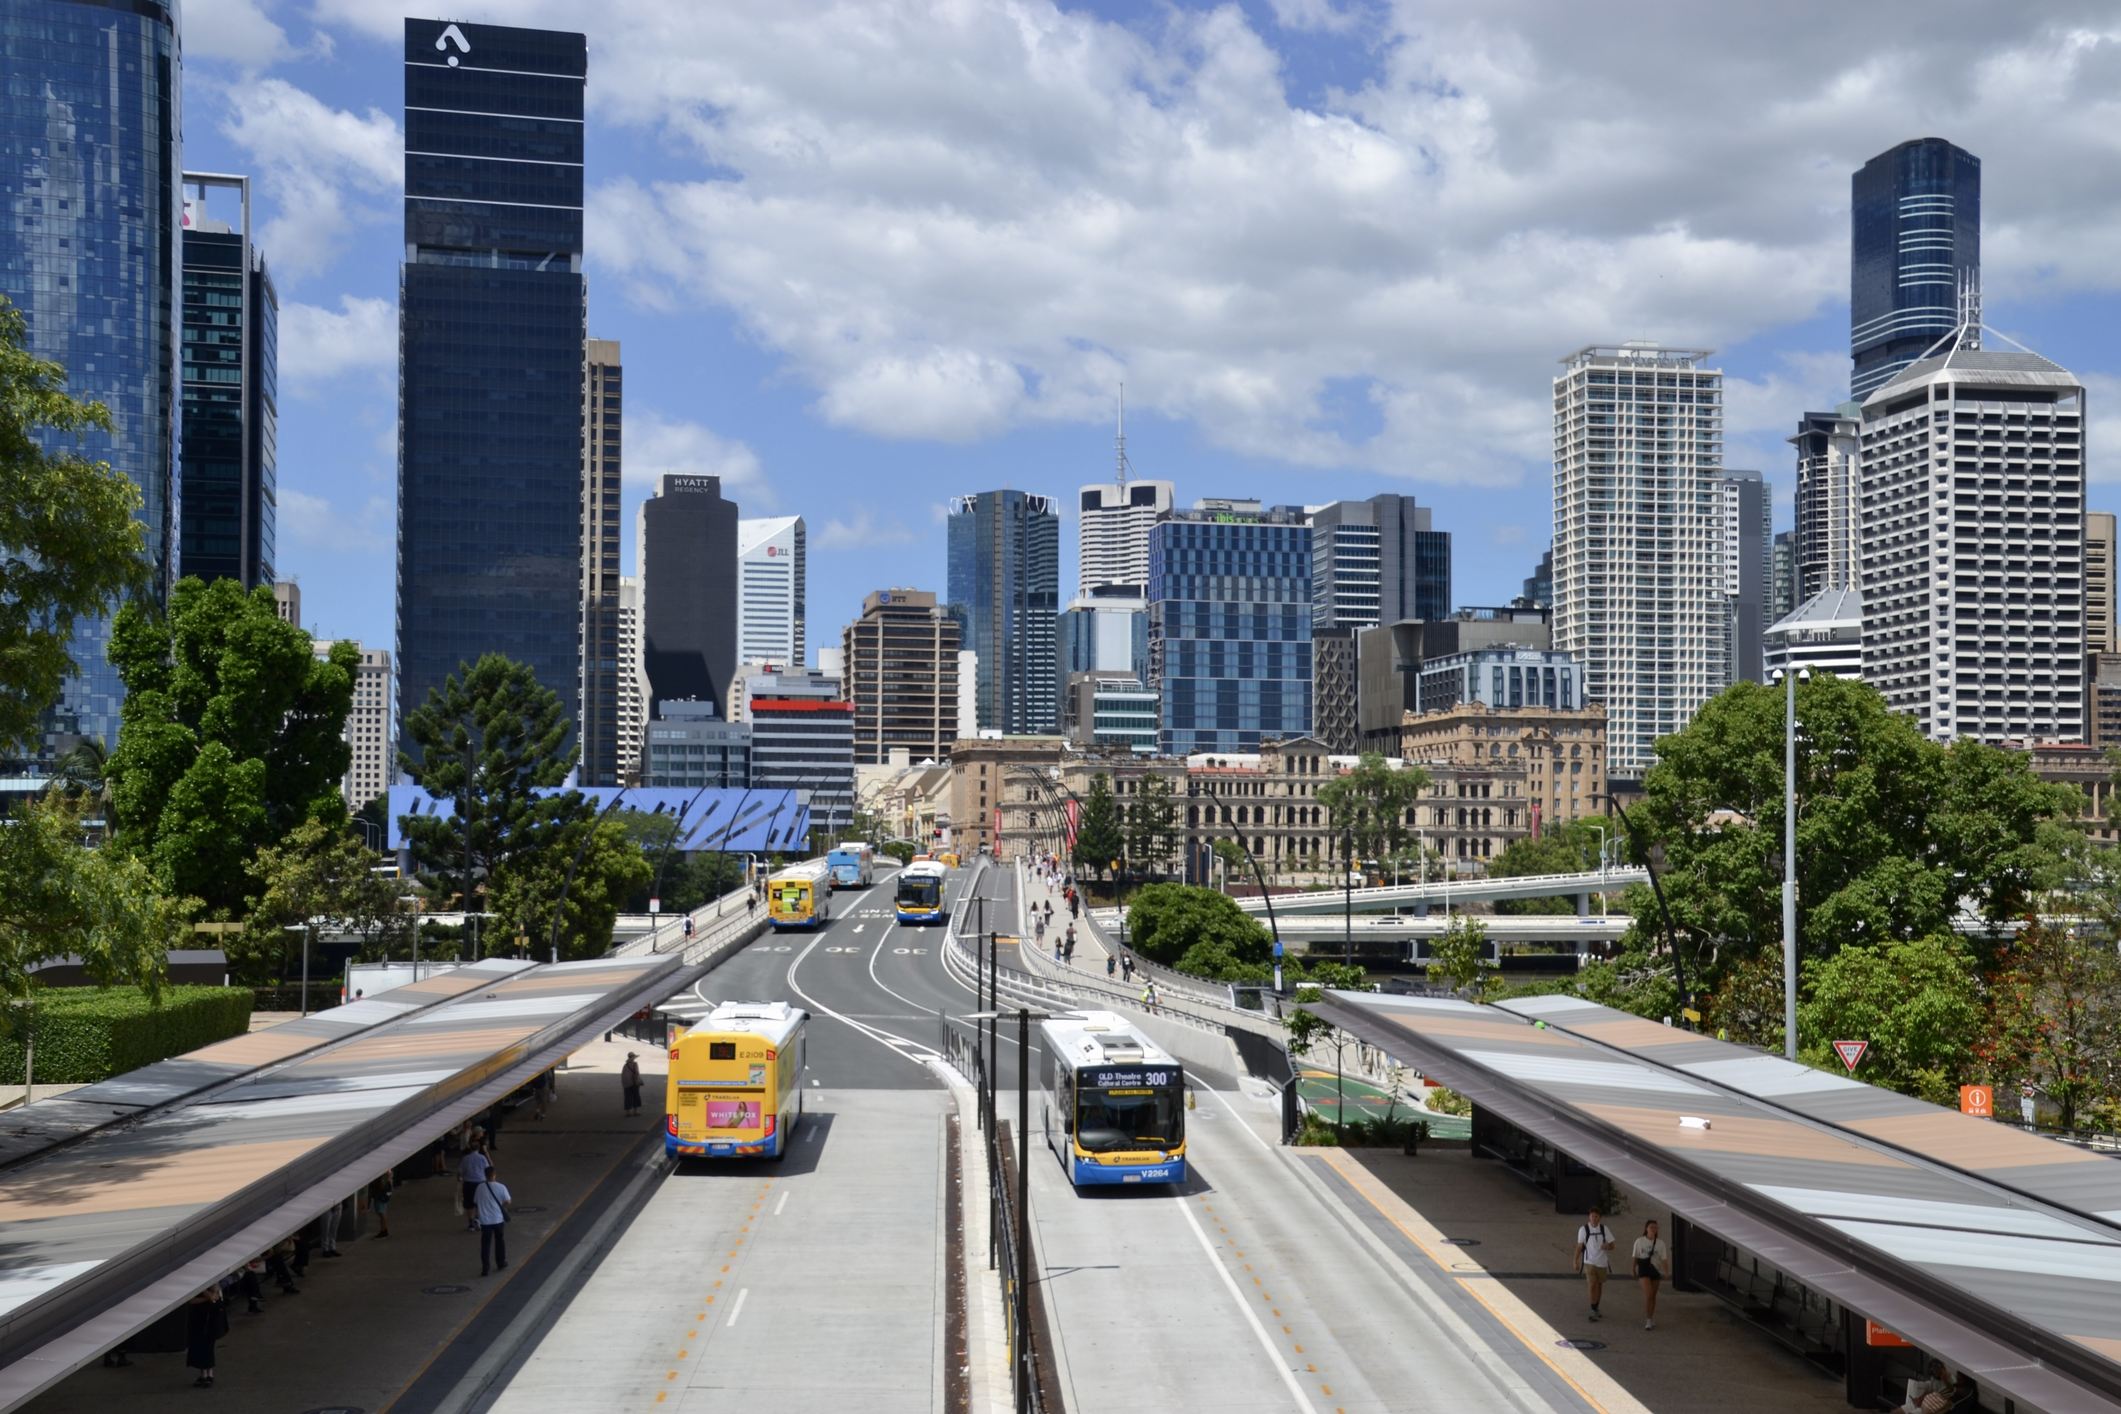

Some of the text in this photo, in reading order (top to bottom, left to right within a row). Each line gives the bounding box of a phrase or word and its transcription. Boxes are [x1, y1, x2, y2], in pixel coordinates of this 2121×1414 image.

[674, 478, 709, 487] HYATT
[674, 486, 709, 494] REGENCY
[777, 548, 790, 556] JLL
[1115, 1072, 1142, 1080] Theatre
[1145, 1072, 1167, 1085] 300
[1141, 1169, 1169, 1178] V2264
